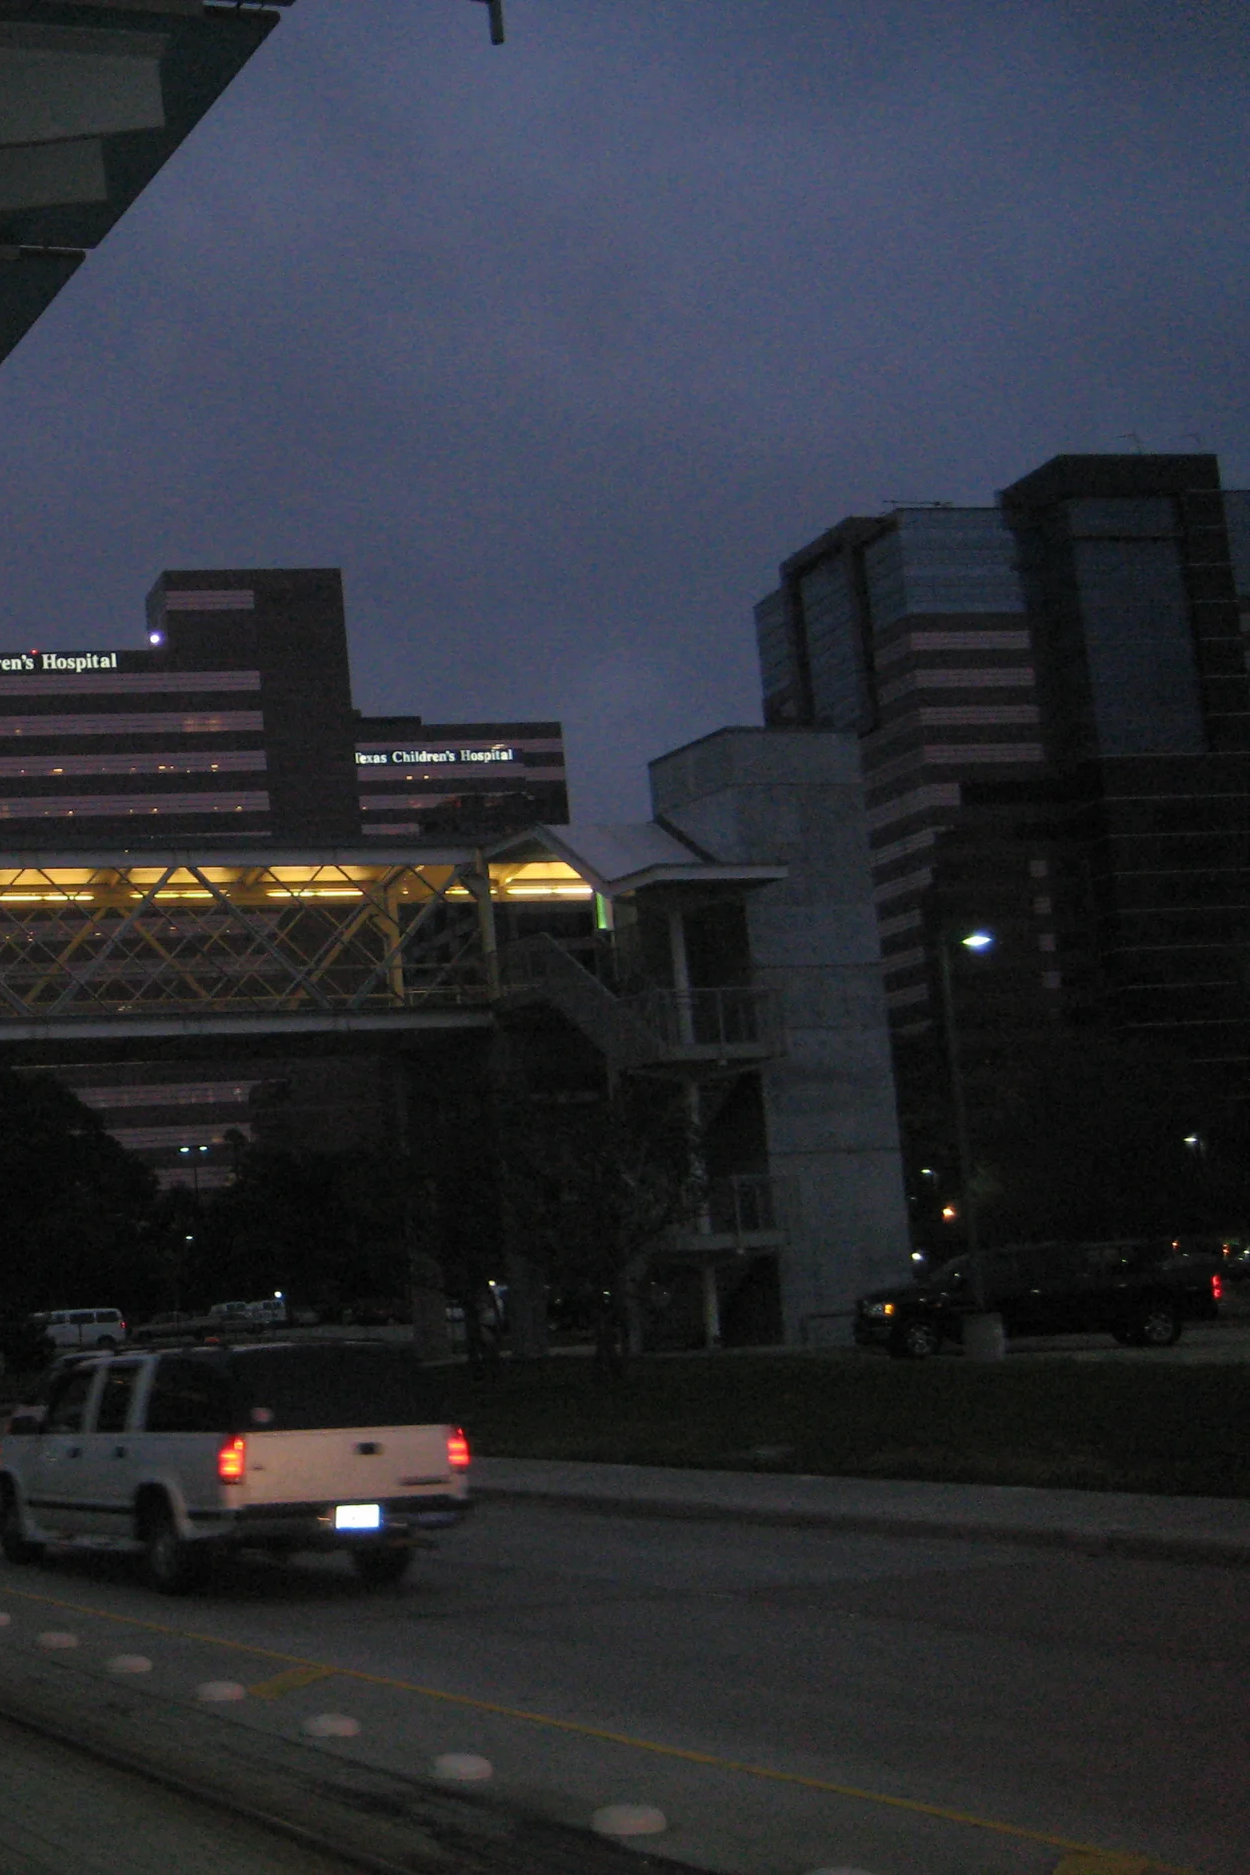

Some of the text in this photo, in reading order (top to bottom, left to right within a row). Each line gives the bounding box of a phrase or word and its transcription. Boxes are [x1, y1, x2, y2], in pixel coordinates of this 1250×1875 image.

[41, 652, 117, 673] Hospital
[391, 750, 456, 763] Children's
[460, 748, 513, 764] Hospital
